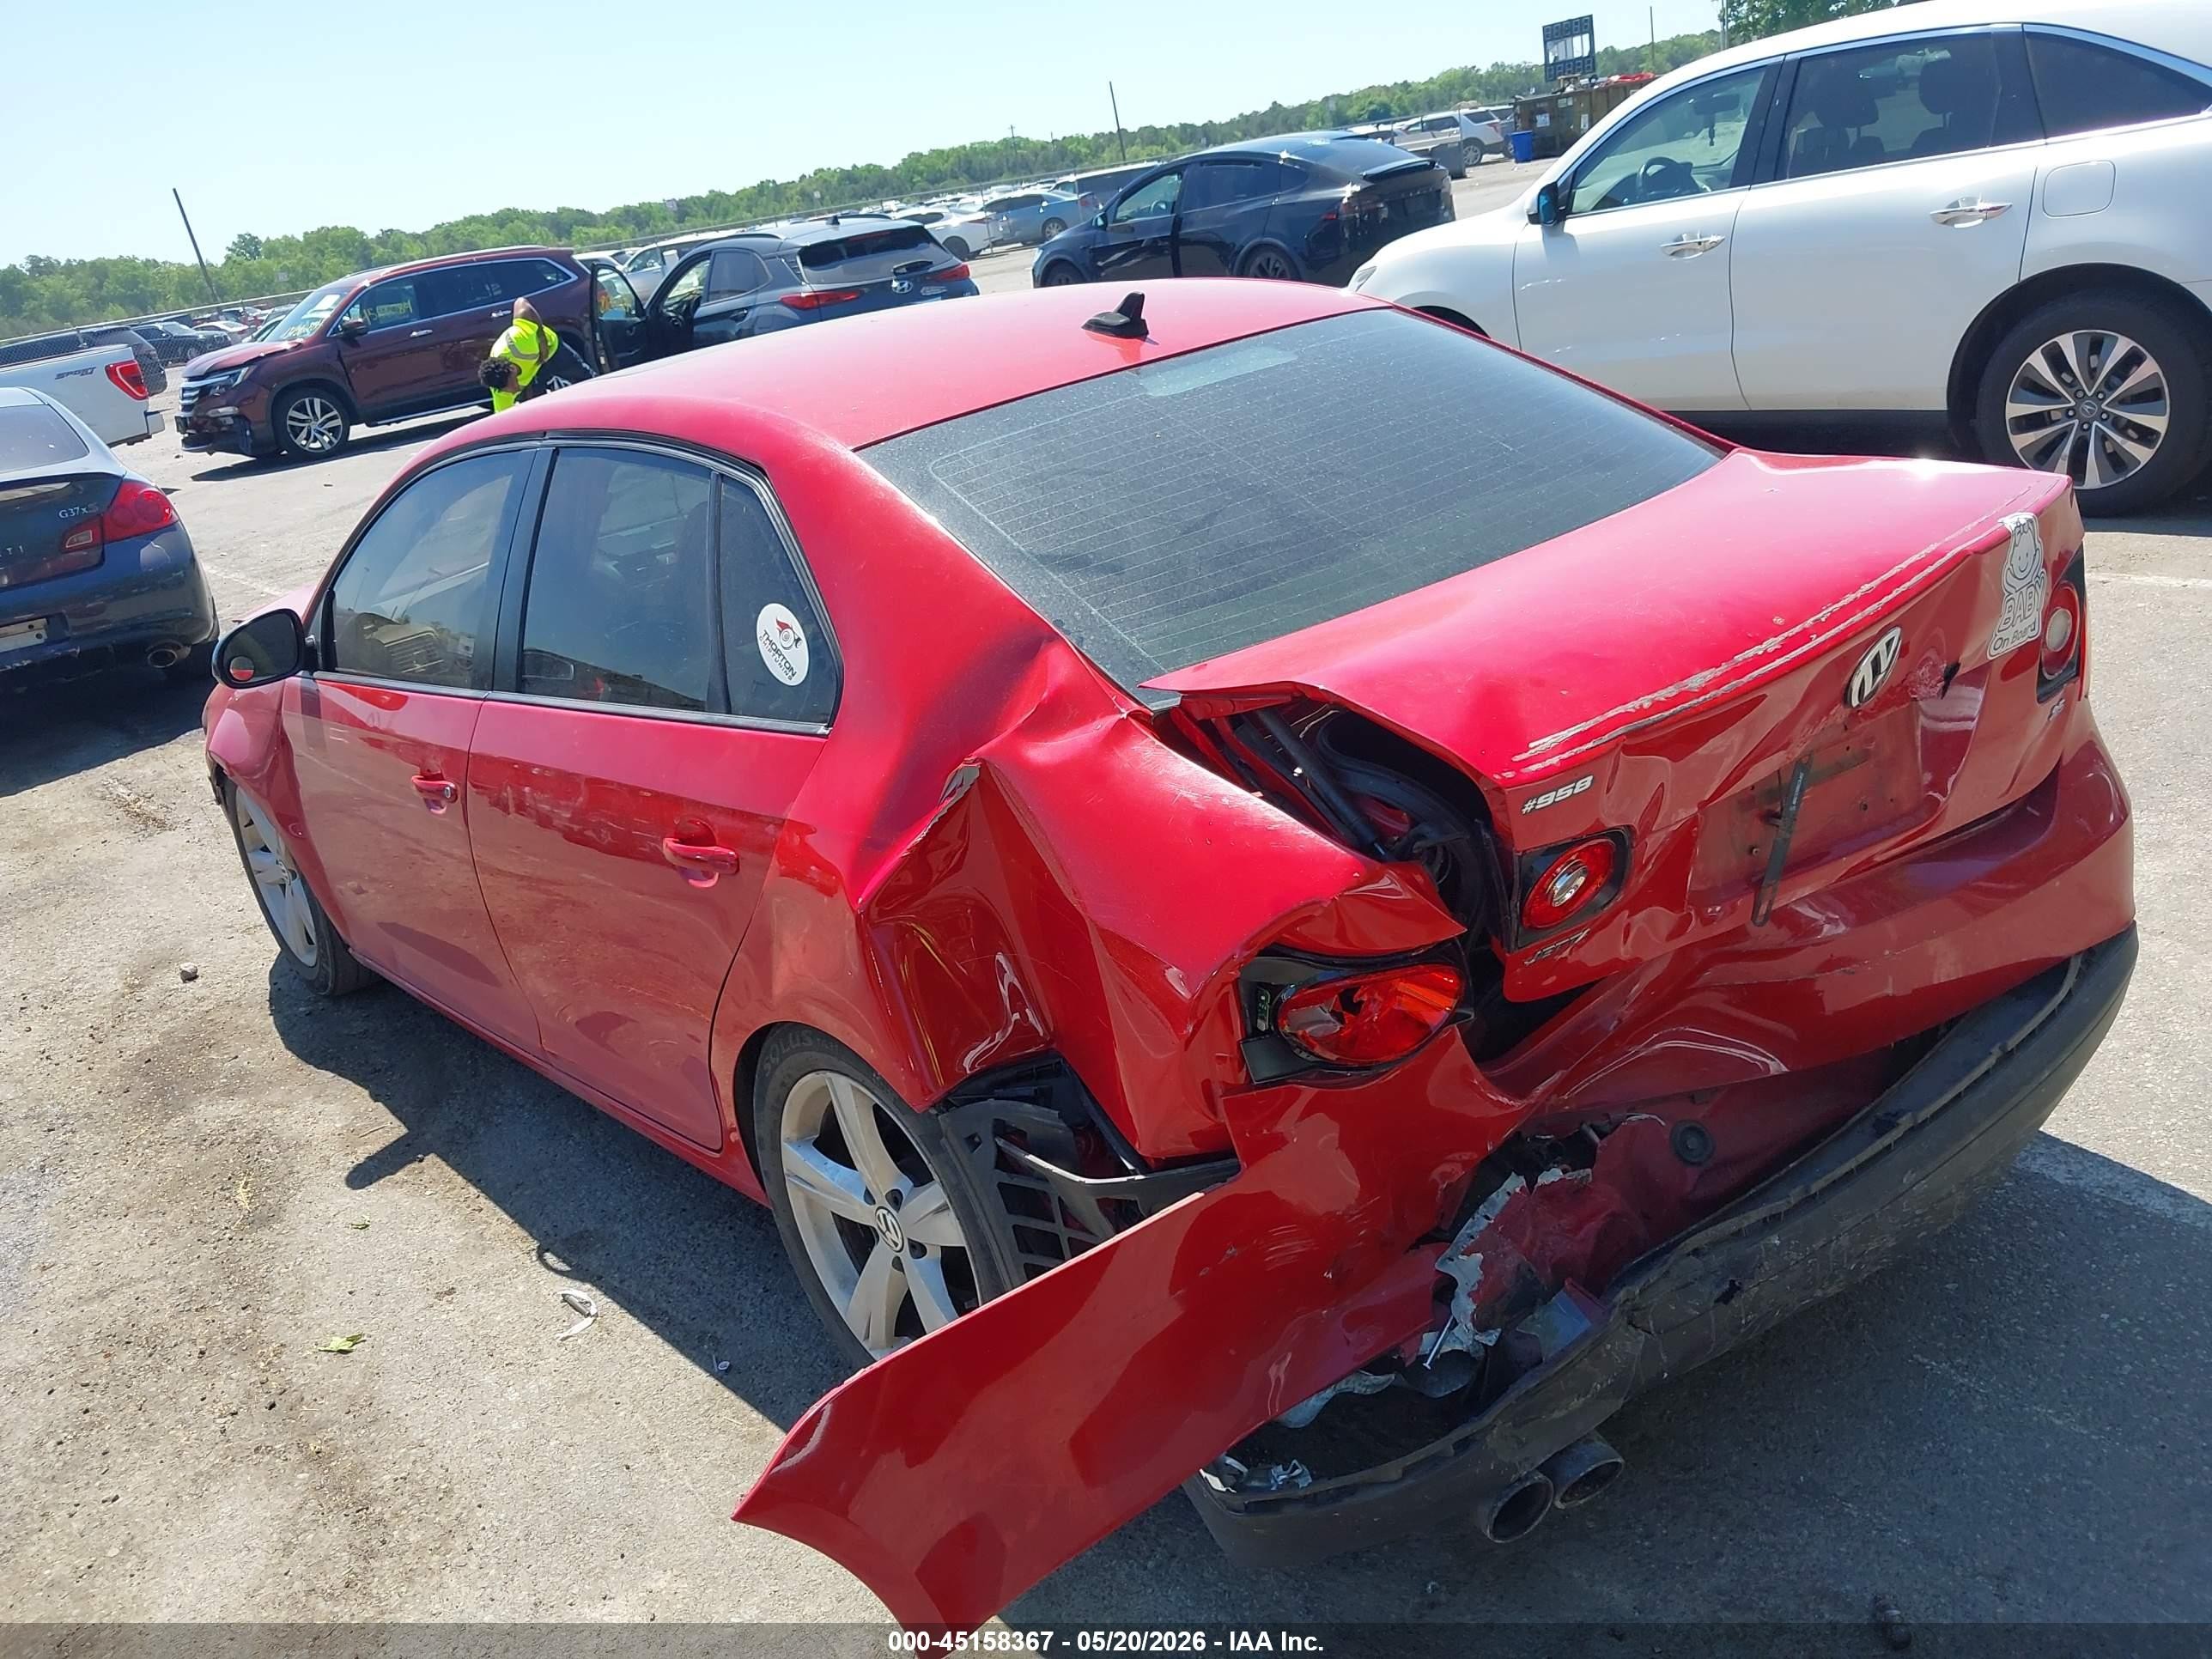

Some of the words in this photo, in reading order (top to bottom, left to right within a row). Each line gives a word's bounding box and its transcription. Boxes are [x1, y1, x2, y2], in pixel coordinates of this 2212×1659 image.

[1997, 570, 2045, 634] BABY
[763, 629, 797, 677] THORTON
[1993, 637, 2009, 651] On
[2011, 618, 2037, 645] Board
[1521, 775, 1594, 816] #958
